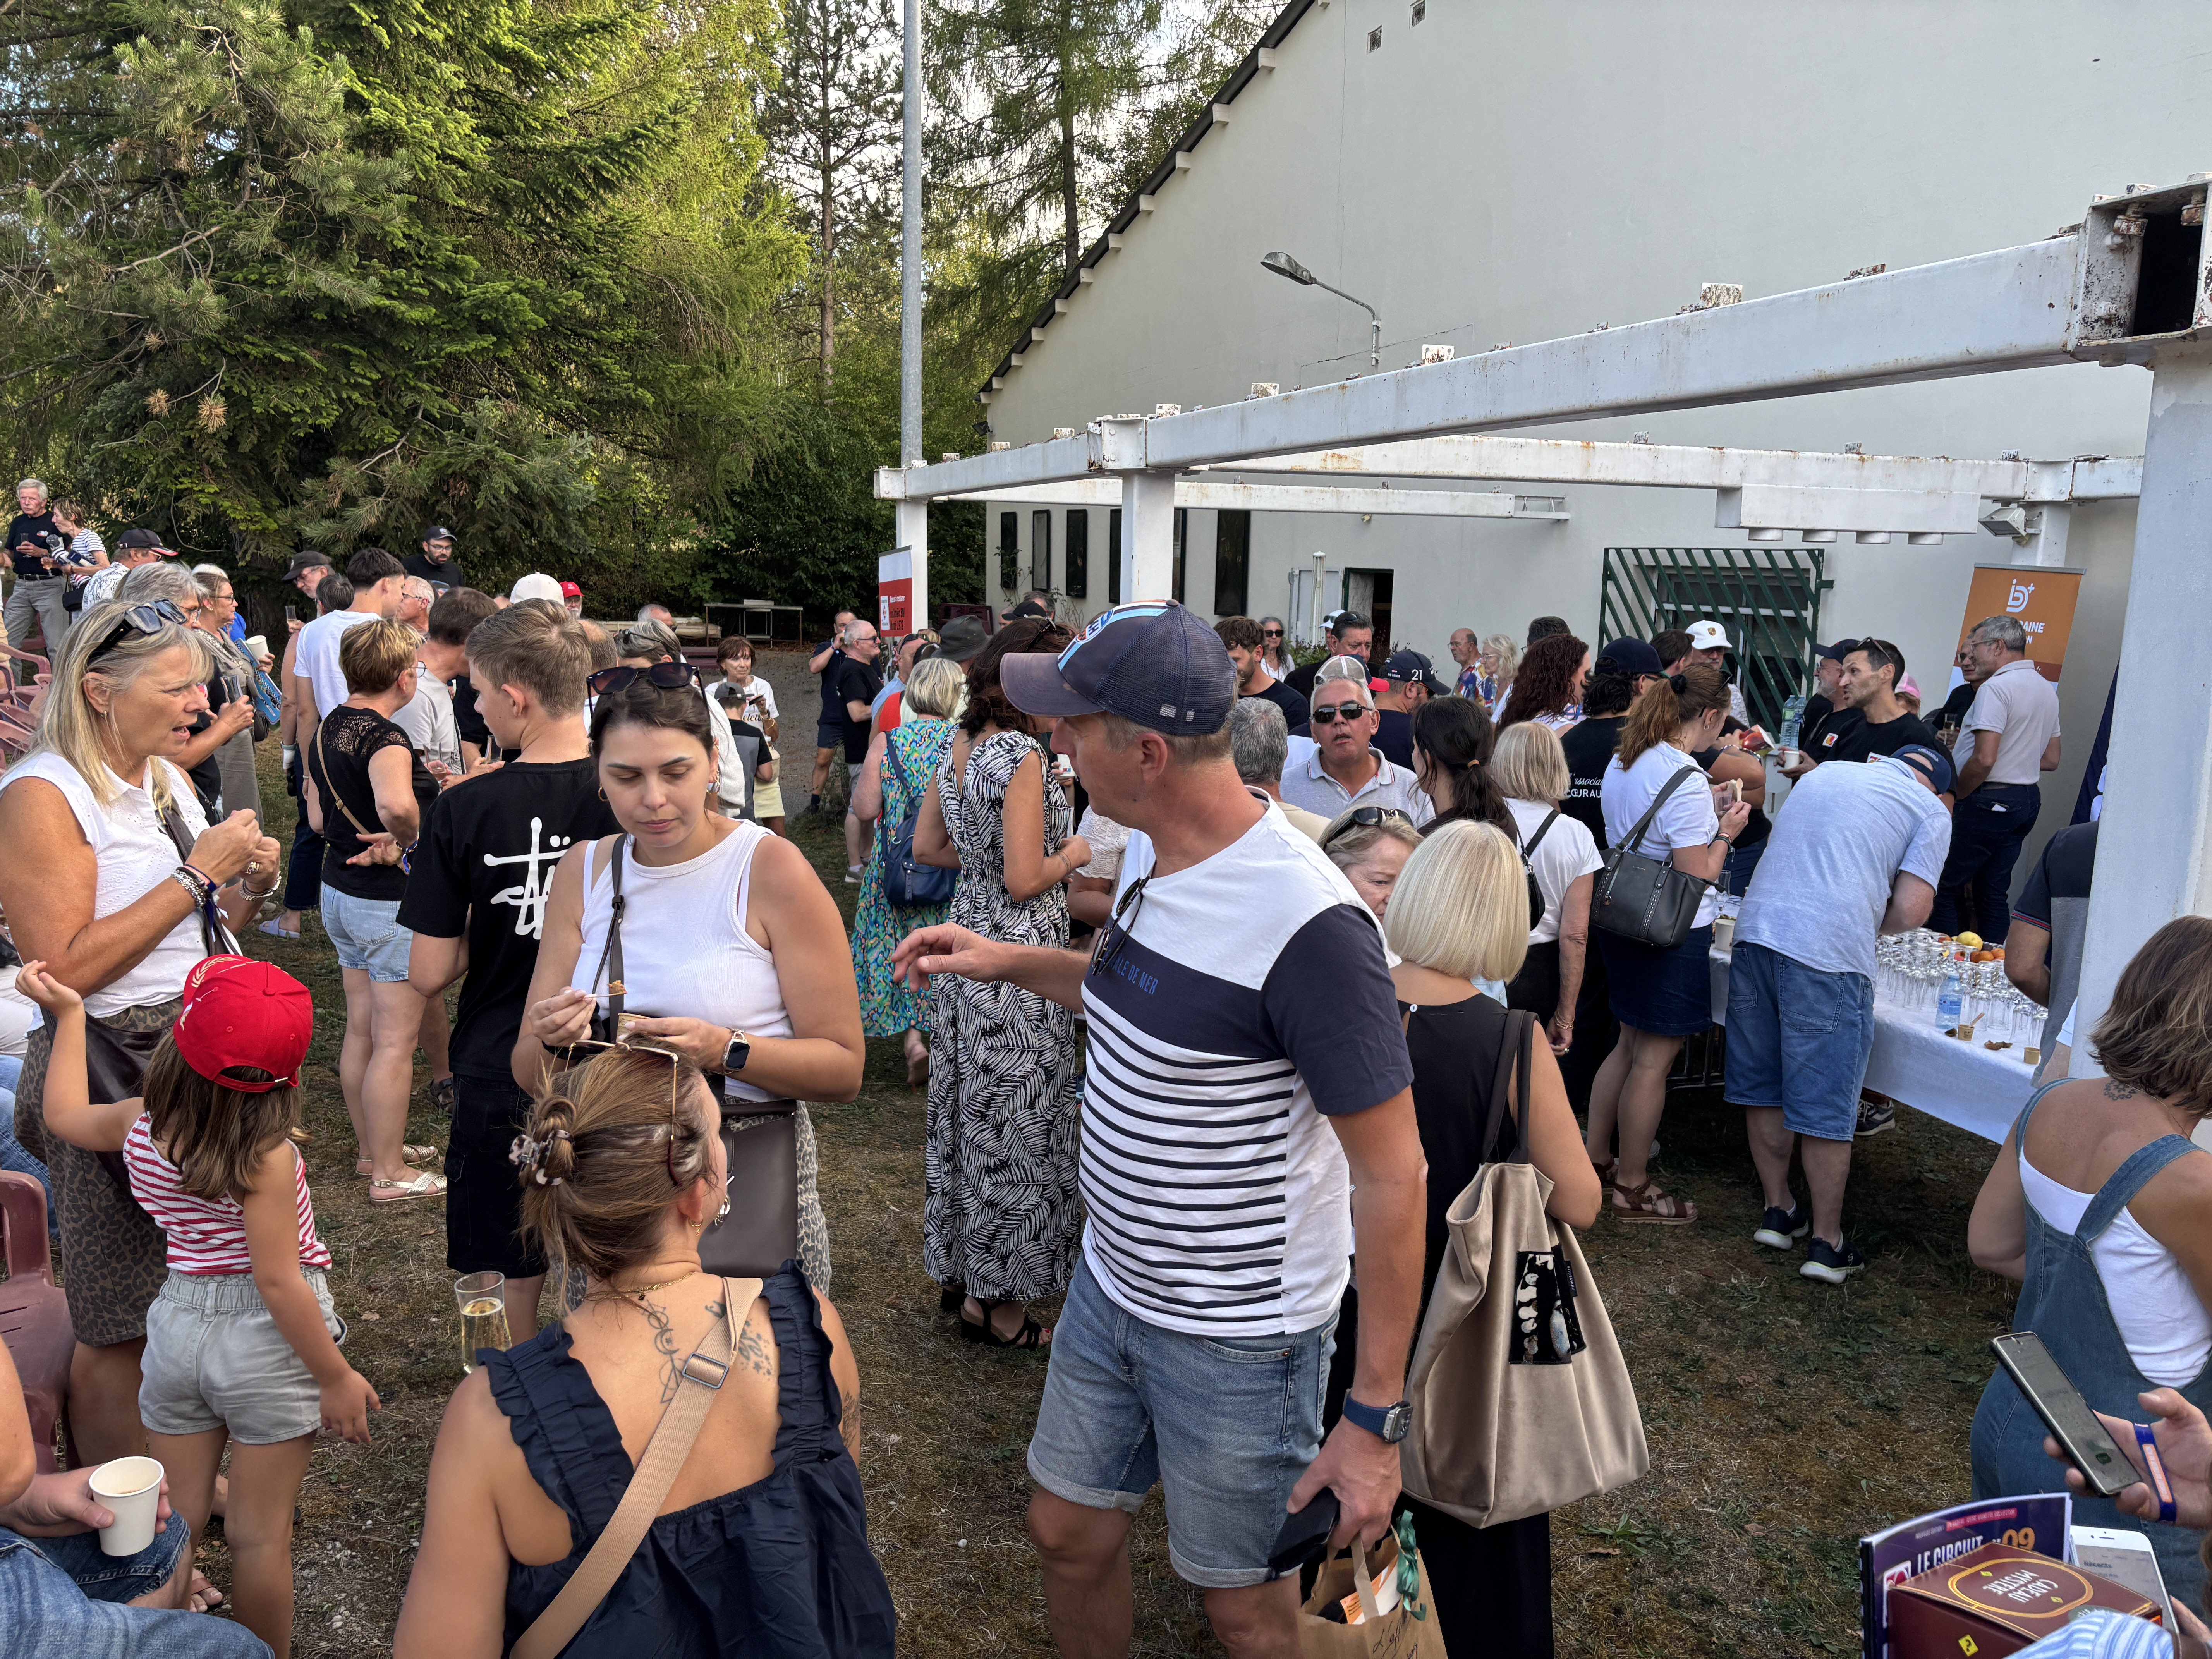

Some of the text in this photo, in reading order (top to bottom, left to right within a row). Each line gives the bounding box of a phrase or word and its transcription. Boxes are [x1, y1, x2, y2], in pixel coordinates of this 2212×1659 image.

[1412, 669, 1422, 680] 21
[1127, 964, 1140, 984] DE
[1138, 972, 1158, 995] MER
[2008, 1578, 2059, 1603] CADEAU
